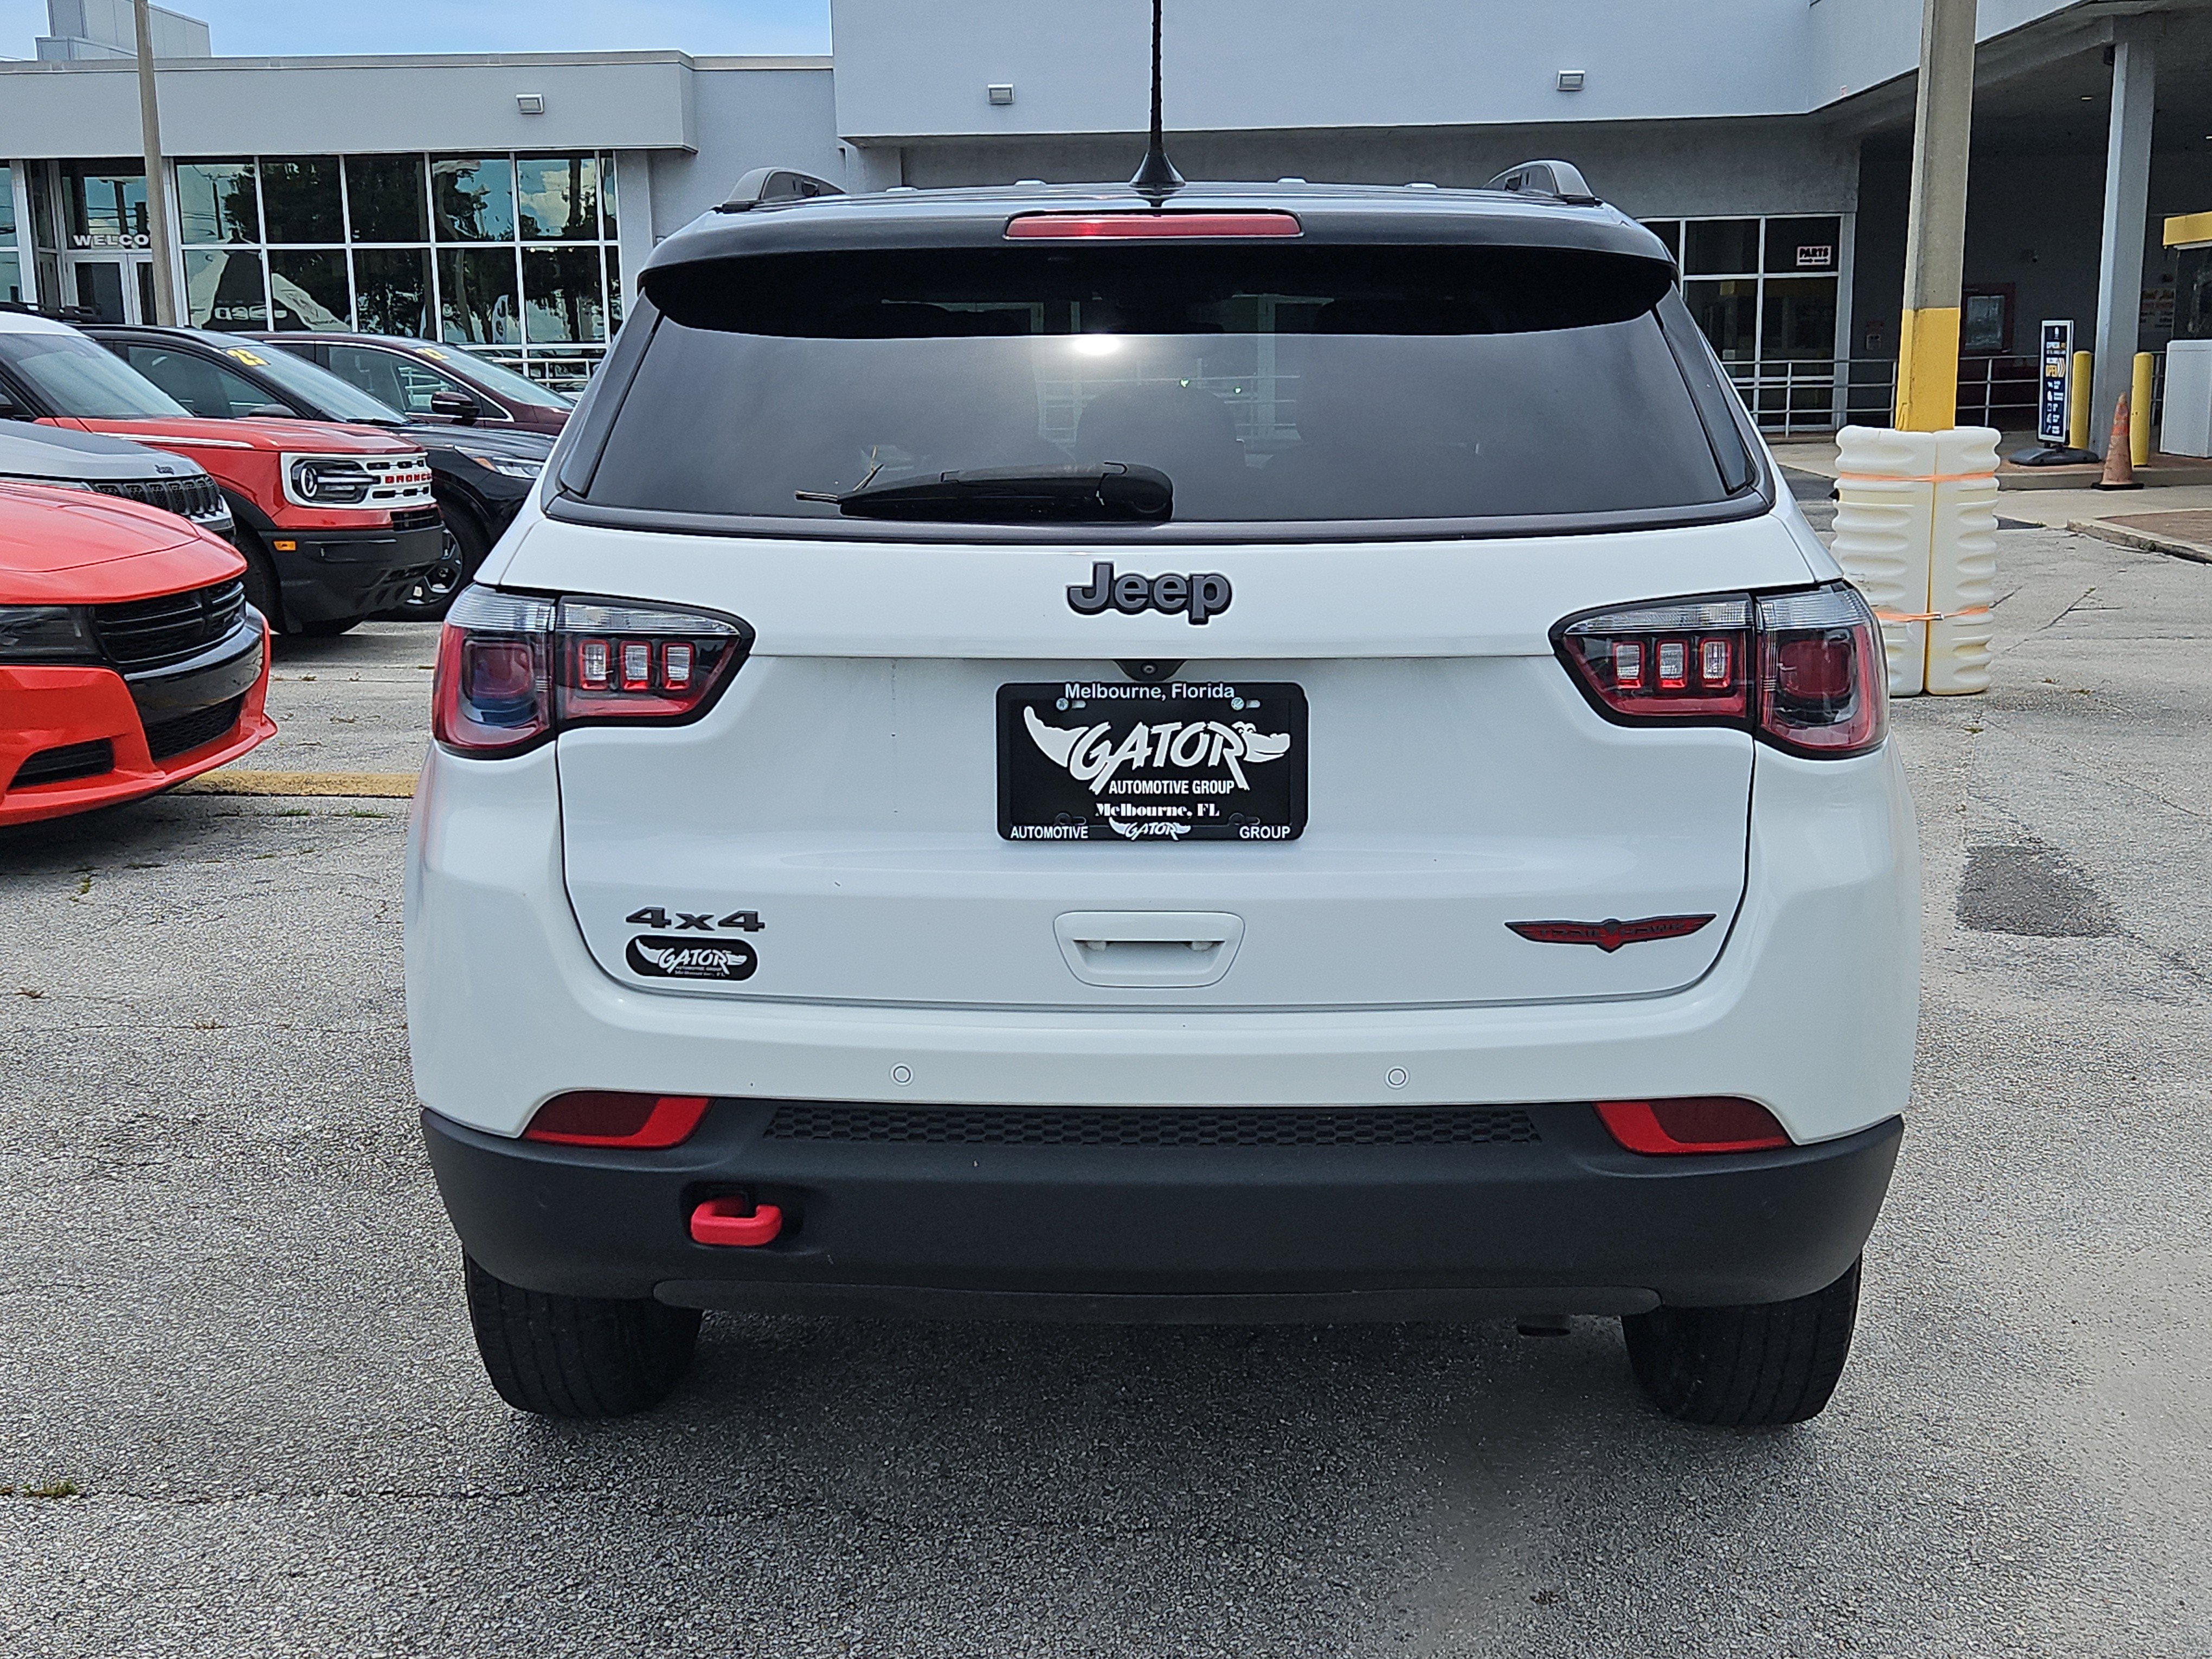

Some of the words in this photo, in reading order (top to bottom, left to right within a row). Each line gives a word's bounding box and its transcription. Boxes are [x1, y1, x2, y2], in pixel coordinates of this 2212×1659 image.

[73, 234, 149, 246] WELCO
[1799, 247, 1829, 258] PARTS
[1066, 562, 1232, 624] Jeep
[1065, 683, 1166, 701] Melbourne,
[1172, 683, 1234, 699] Florida
[1070, 721, 1250, 795] GATOR
[1109, 781, 1189, 794] AUTOMOTIVE
[1192, 781, 1234, 794] GROUP
[1095, 803, 1192, 819] Melbourne,
[1197, 803, 1219, 816] FL
[1010, 826, 1089, 839] AUTOMOTIVE
[1126, 822, 1179, 840] GATOR
[1239, 826, 1290, 839] GROUP
[626, 906, 765, 932] 4x4
[658, 948, 730, 974] GATOR
